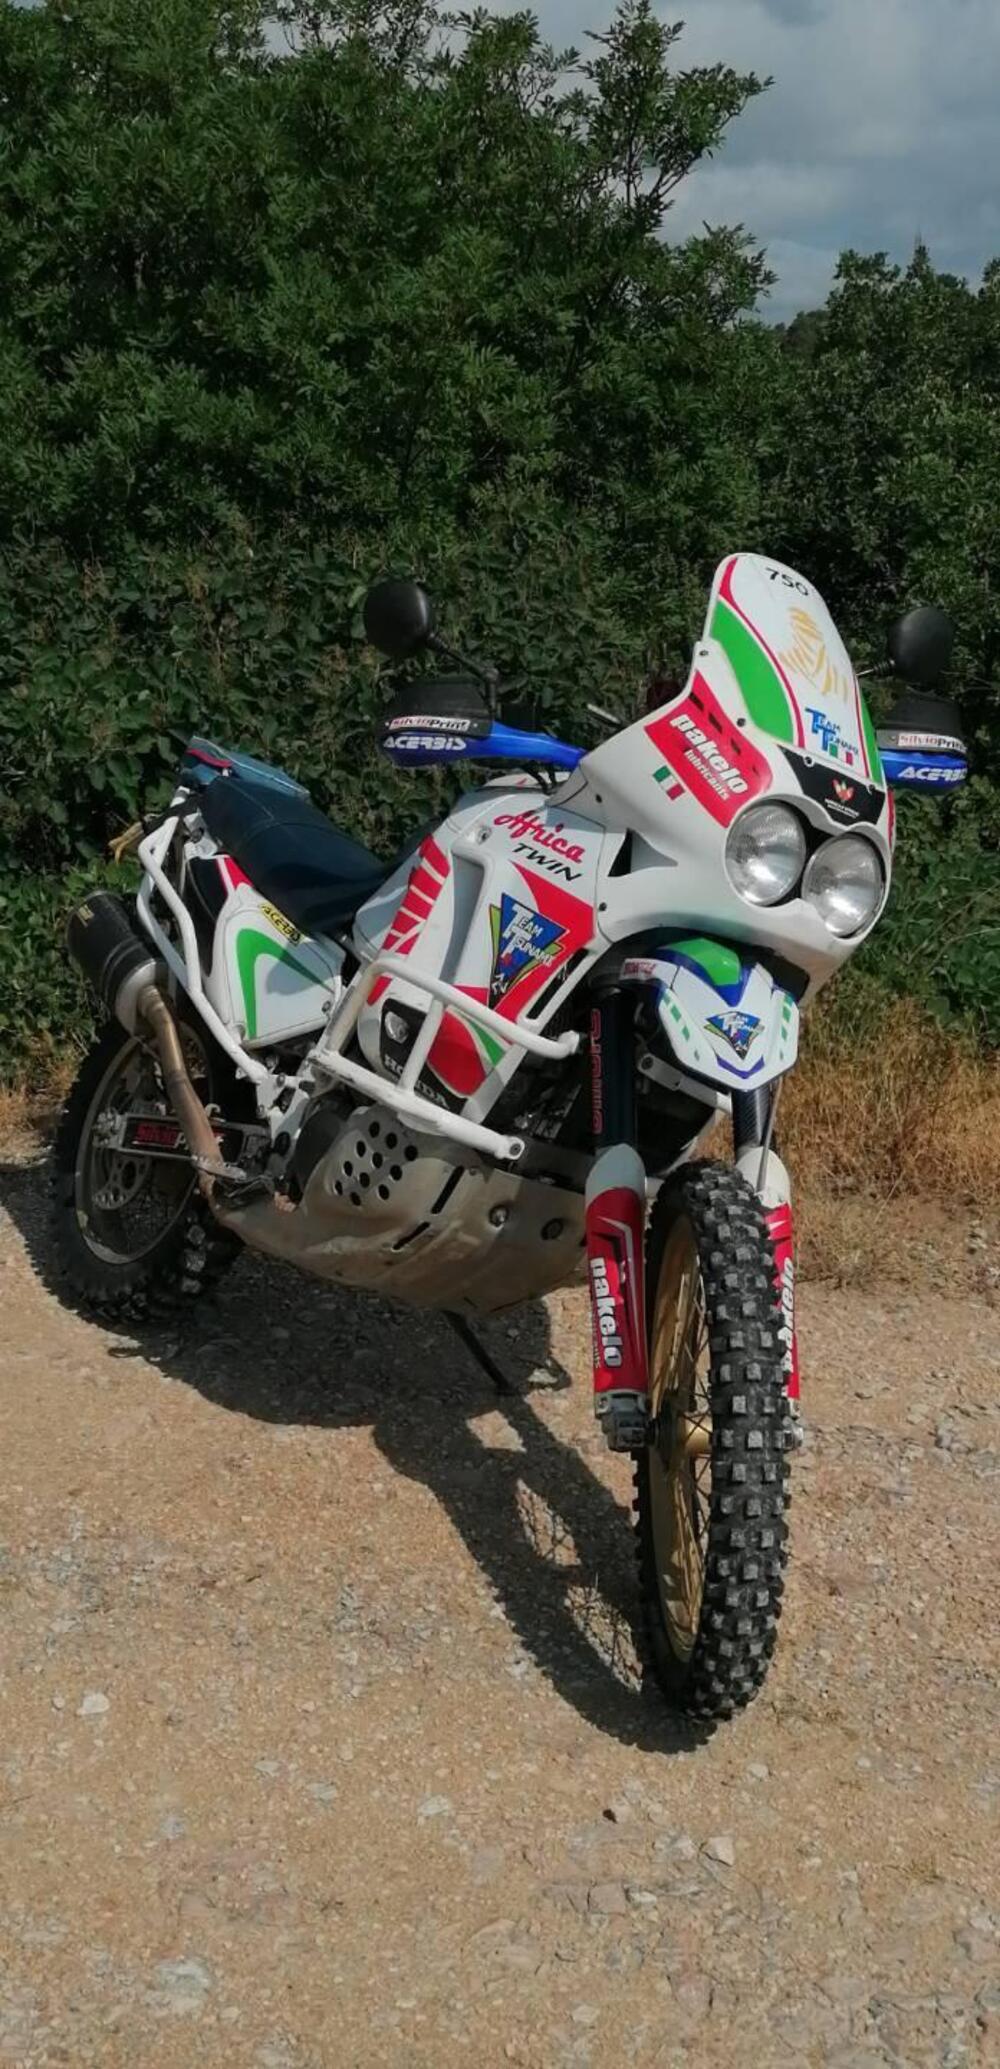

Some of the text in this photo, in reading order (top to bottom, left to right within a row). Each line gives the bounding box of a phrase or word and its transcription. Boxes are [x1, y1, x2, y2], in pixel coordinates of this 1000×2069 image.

[765, 567, 809, 596] 750
[383, 735, 467, 750] ACERBIS
[669, 714, 748, 794] pakelo
[684, 748, 729, 801] lubricants
[493, 809, 586, 864] Africa
[512, 842, 583, 882] TWIN
[502, 902, 544, 940] TEAM
[590, 1257, 623, 1368] pakelo
